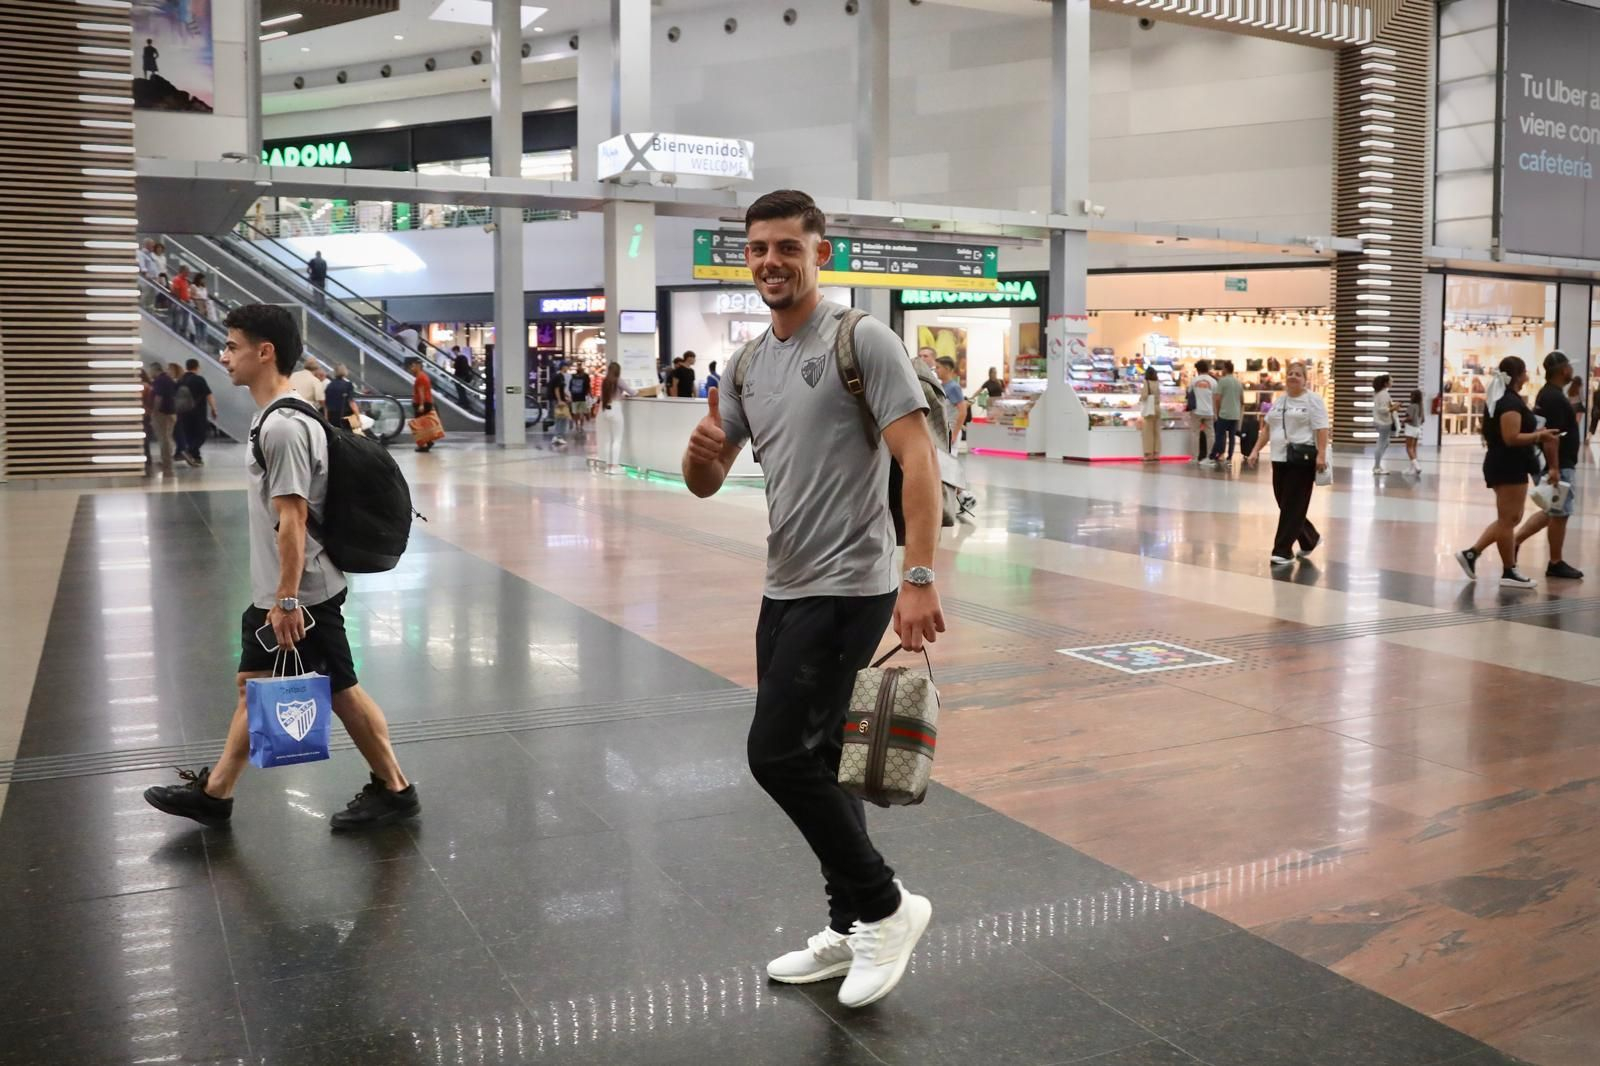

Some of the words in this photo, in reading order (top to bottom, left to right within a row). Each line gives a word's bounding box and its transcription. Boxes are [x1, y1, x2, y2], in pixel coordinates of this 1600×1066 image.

[1520, 73, 1543, 99] Tu
[1546, 78, 1588, 108] Uber
[1519, 112, 1567, 139] viene
[652, 137, 745, 158] Bienvenidos
[691, 157, 745, 173] WELCOME
[1519, 149, 1593, 178] cafetería
